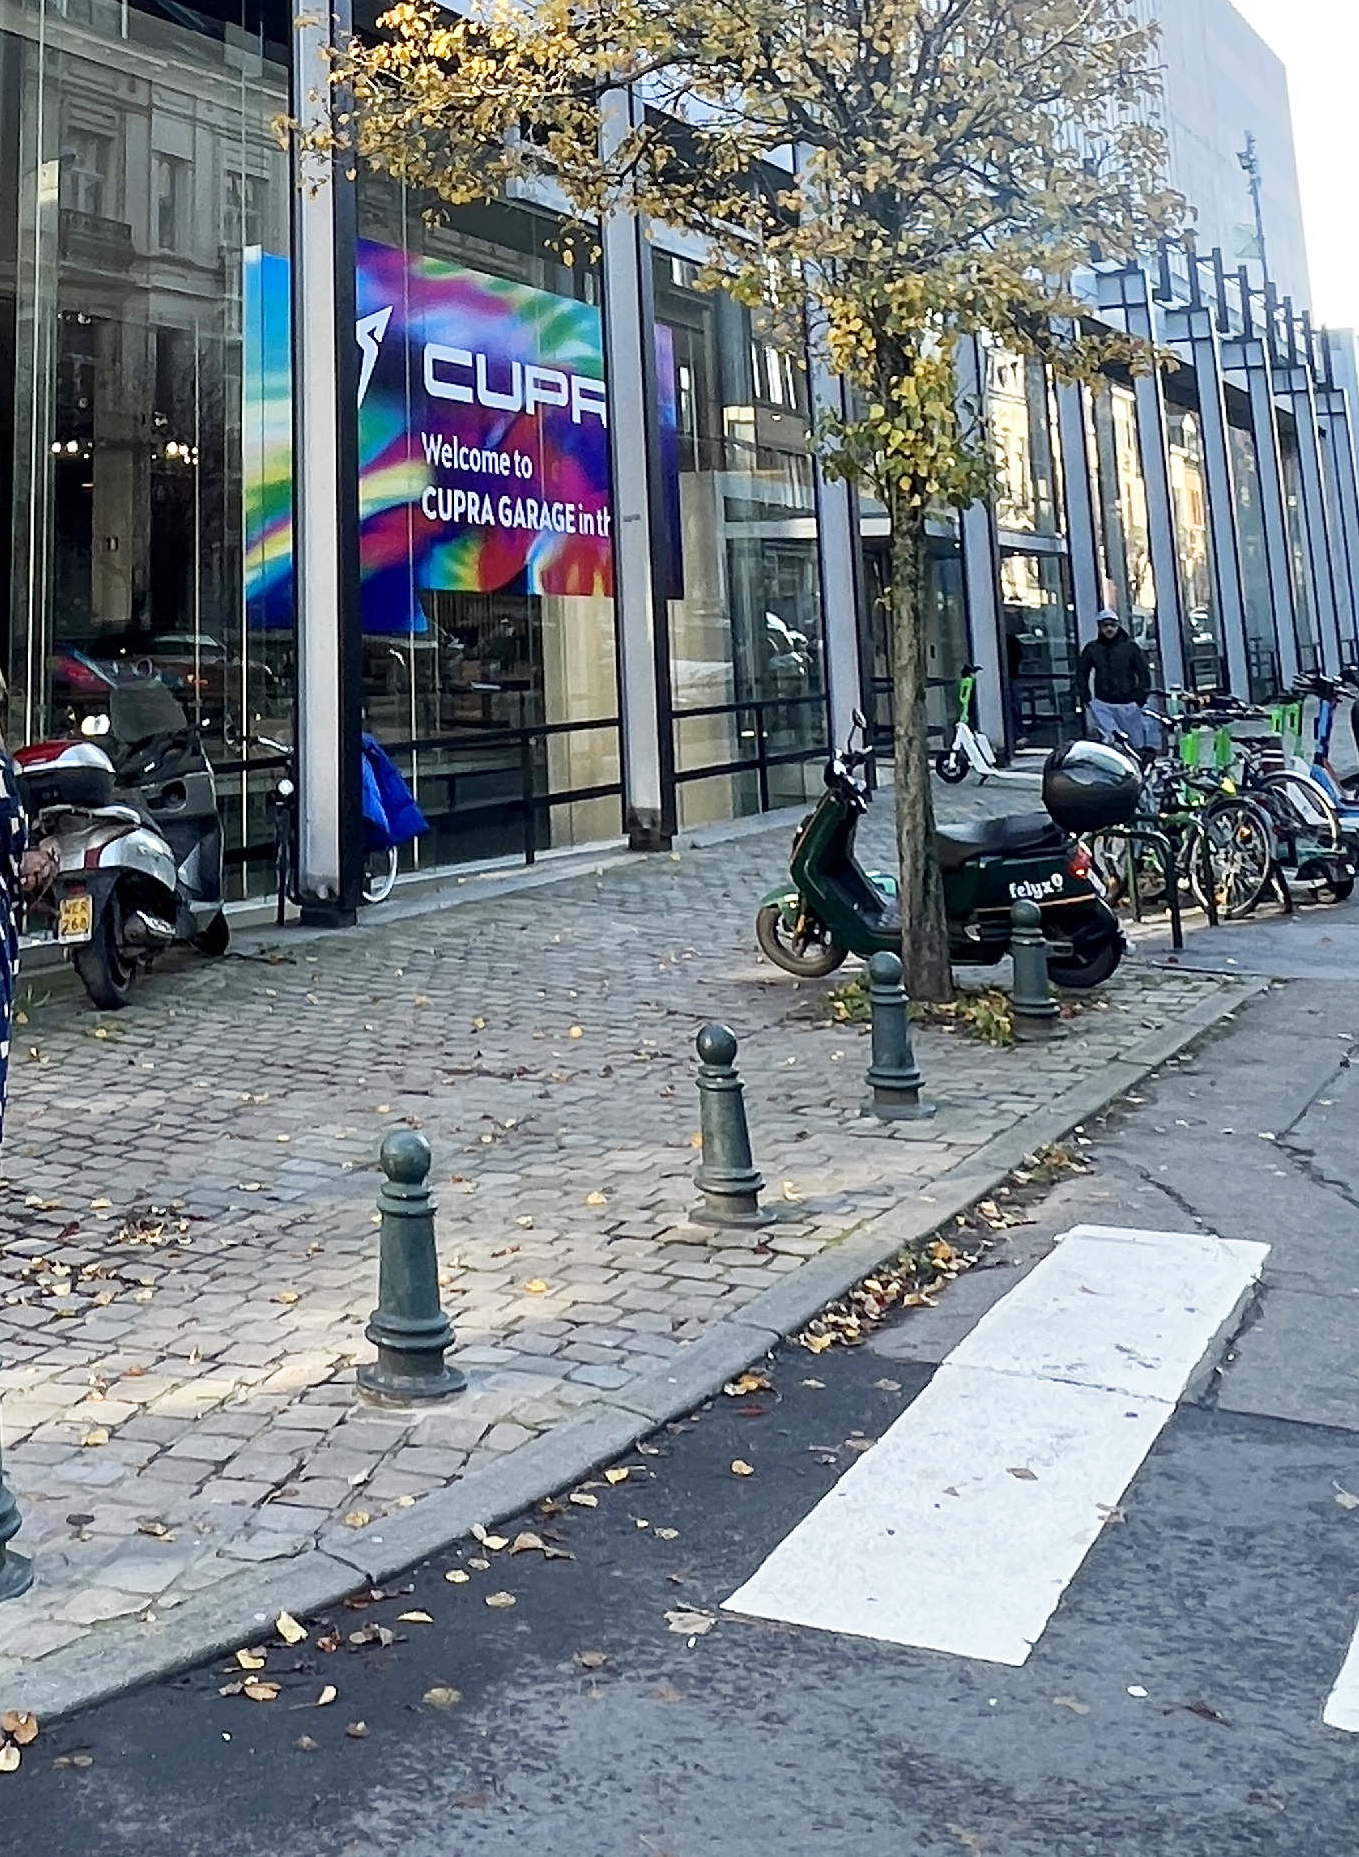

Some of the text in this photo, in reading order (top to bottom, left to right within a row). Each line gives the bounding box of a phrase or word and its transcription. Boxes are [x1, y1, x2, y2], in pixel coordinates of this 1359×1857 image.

[421, 431, 533, 479] Welcome to
[421, 485, 496, 527] CUPRA
[497, 494, 577, 534] GARAGE
[578, 503, 595, 536] in
[1009, 880, 1055, 899] felyx
